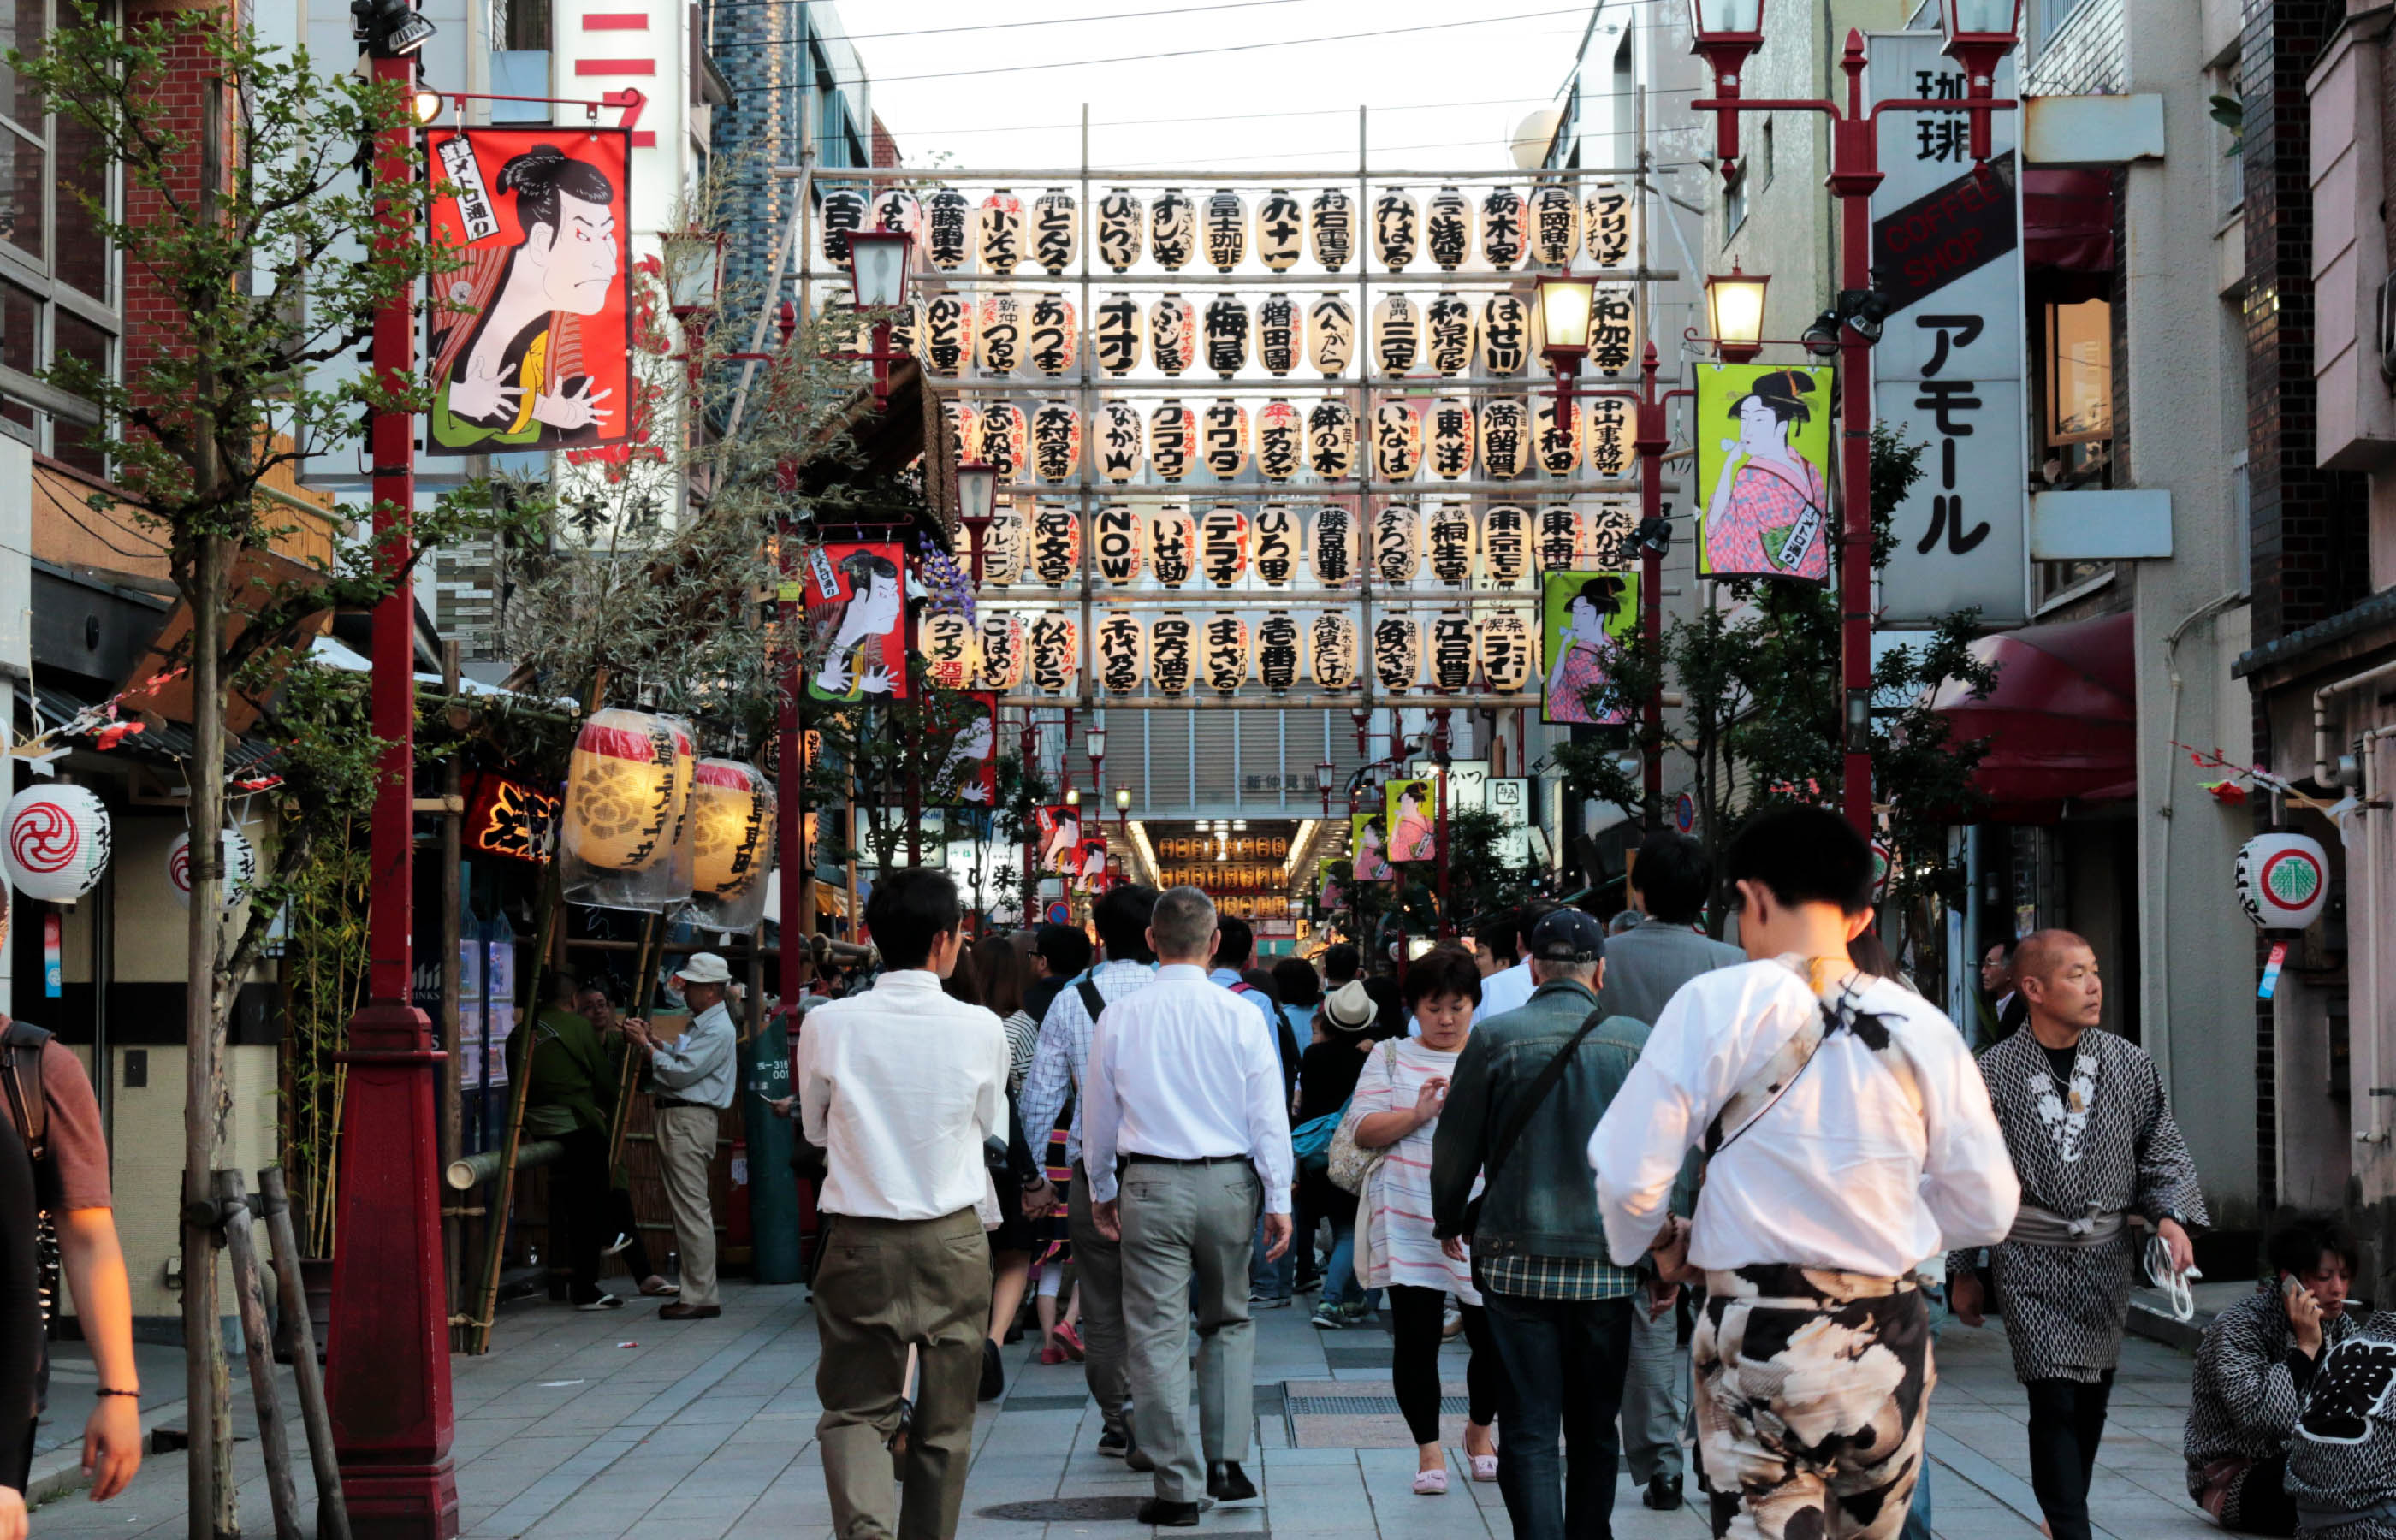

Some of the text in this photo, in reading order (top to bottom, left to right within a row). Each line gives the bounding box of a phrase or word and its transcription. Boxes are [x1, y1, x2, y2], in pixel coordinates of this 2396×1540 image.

[454, 158, 489, 235] メトロ通り
[1100, 197, 1132, 264] ひらい
[1153, 194, 1185, 264] すし栄
[1378, 196, 1414, 264] みはる
[1585, 201, 1600, 259] キッチン
[1885, 175, 2001, 252] COFFEE
[1903, 227, 1983, 287] SHOP
[1032, 302, 1065, 370] あづま
[1381, 322, 1416, 370] 三定
[1486, 300, 1522, 370] はせ川
[1154, 407, 1183, 476] クラウン
[1207, 406, 1242, 471] サワダ
[1308, 406, 1347, 473] 鉢の木
[1378, 406, 1409, 474] いなば
[1436, 410, 1465, 472] 東洋
[1594, 400, 1624, 471] 中山事務所
[1914, 315, 1990, 555] アモール
[1101, 512, 1130, 578] NOW
[1032, 618, 1066, 687] 松むら
[1061, 620, 1075, 677] とんかつ
[1209, 619, 1239, 688] まさる
